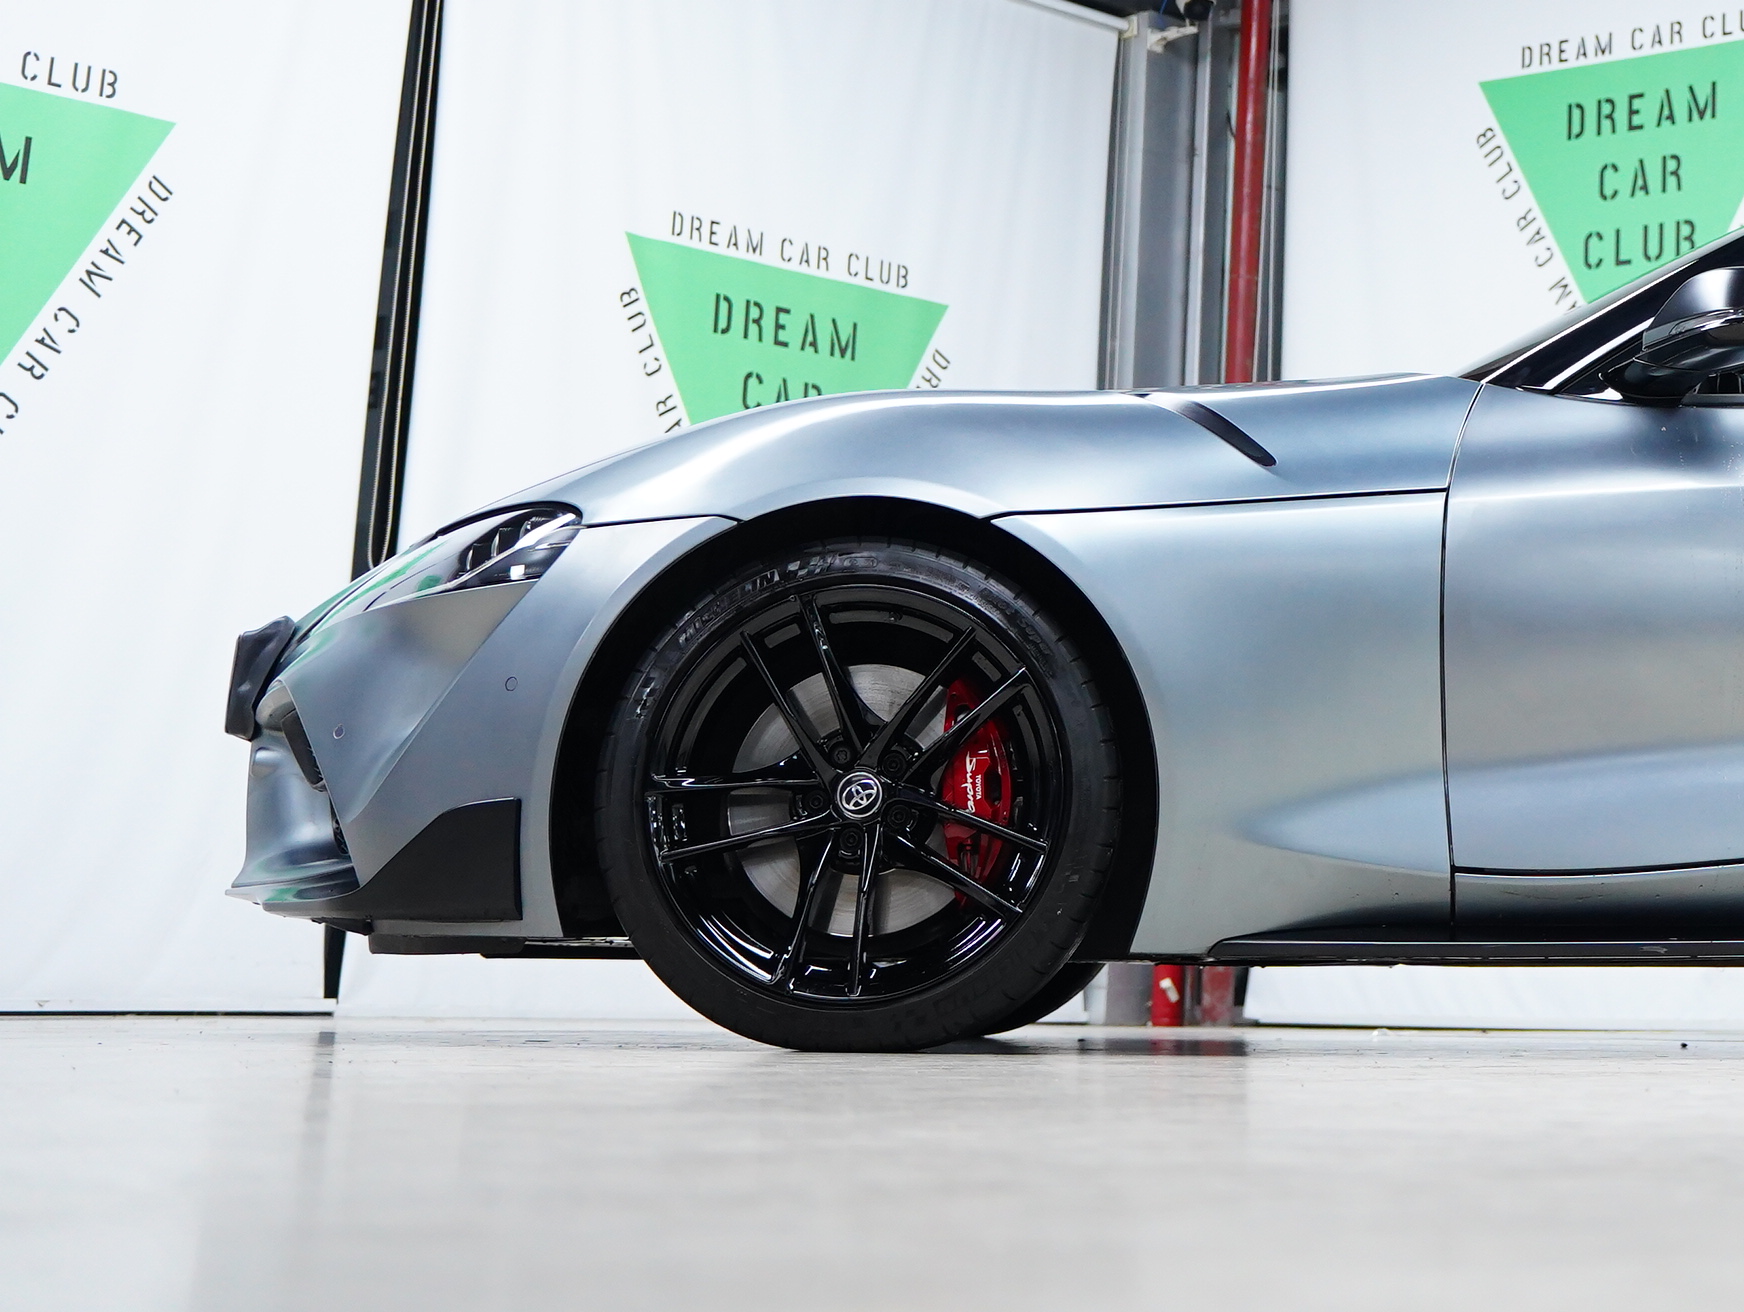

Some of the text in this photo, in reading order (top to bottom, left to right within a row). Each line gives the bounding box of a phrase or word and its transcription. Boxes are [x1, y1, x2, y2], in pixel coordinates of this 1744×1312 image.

[20, 50, 119, 100] CLUB
[1520, 32, 1613, 70] DREAM
[1630, 20, 1684, 51] CAR
[1566, 80, 1718, 141] DREAM
[1476, 127, 1555, 268] CAR CLUB
[1598, 154, 1685, 202] CAR
[671, 210, 909, 289] DREAM CAR CLUB
[1583, 218, 1697, 270] CLUB
[16, 174, 174, 381] DREAM CAR
[619, 286, 663, 377] CLUB
[713, 292, 859, 362] DREAM
